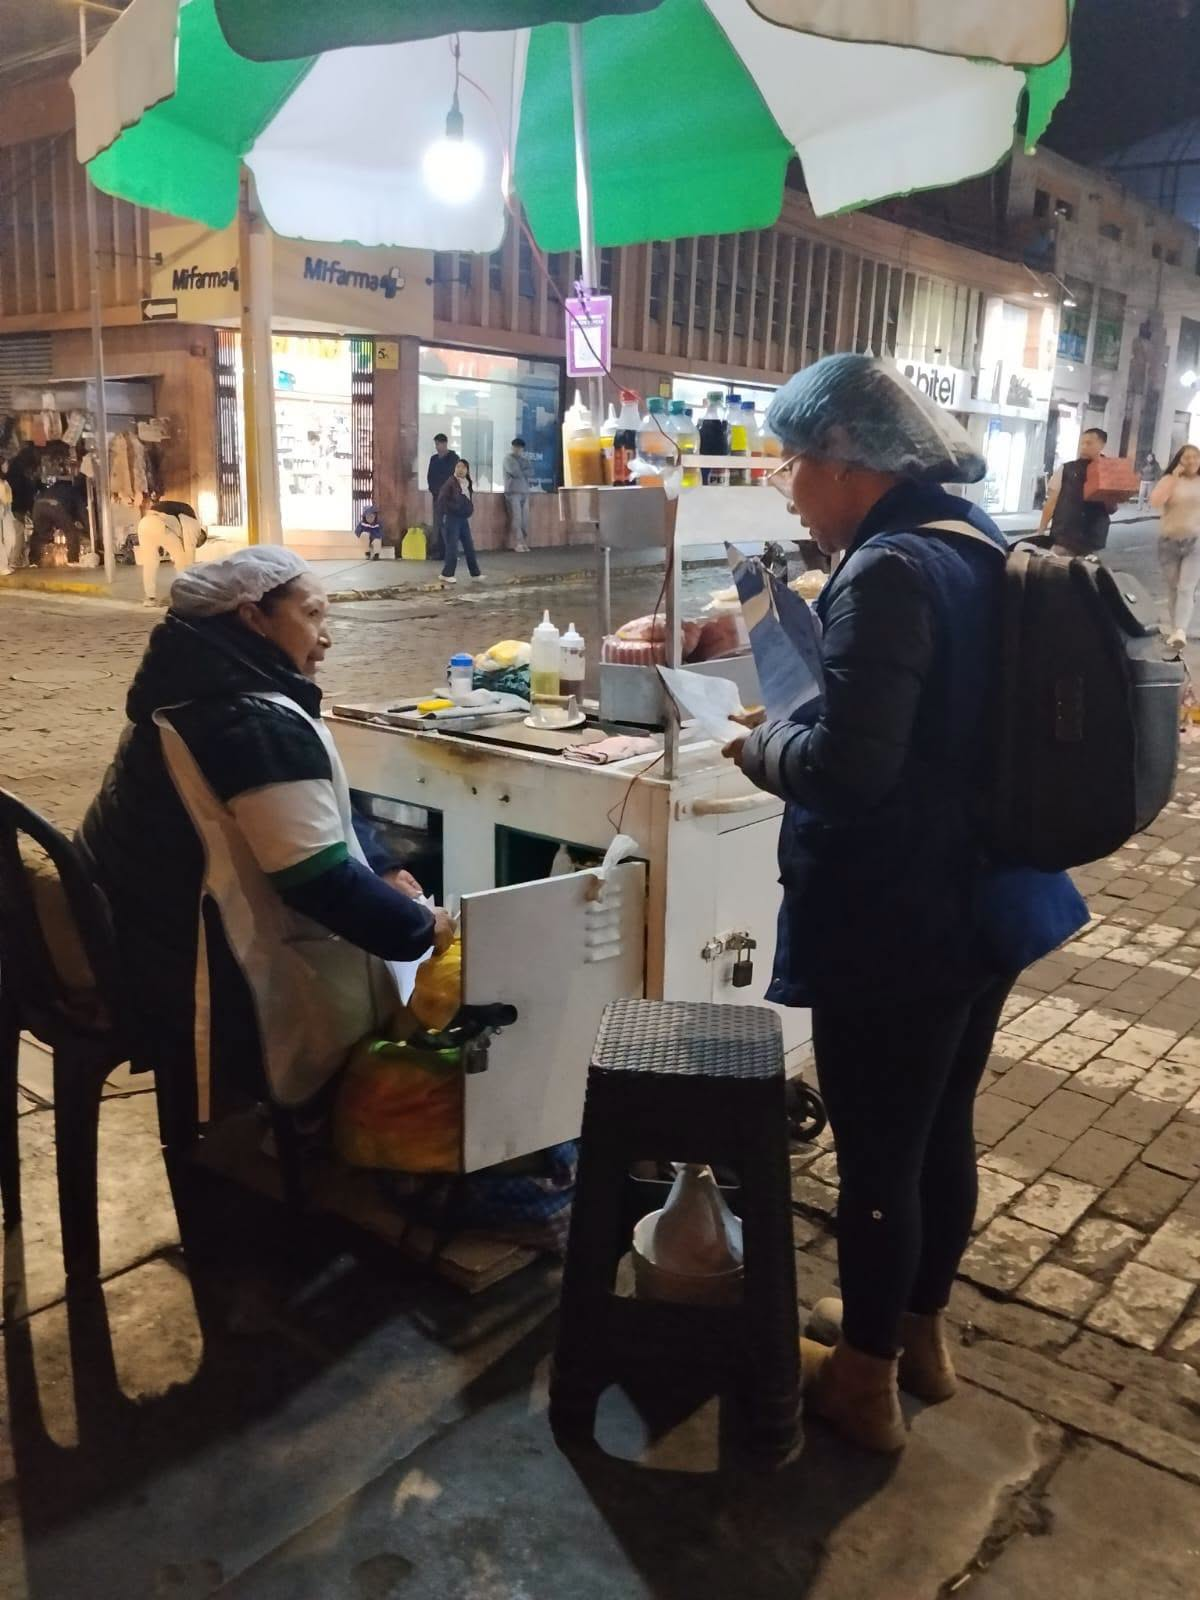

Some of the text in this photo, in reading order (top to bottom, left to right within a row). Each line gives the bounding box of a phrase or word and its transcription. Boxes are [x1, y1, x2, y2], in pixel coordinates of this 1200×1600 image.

[172, 265, 228, 291] Mifarma
[303, 256, 380, 292] Mifarma
[916, 366, 957, 405] bitel
